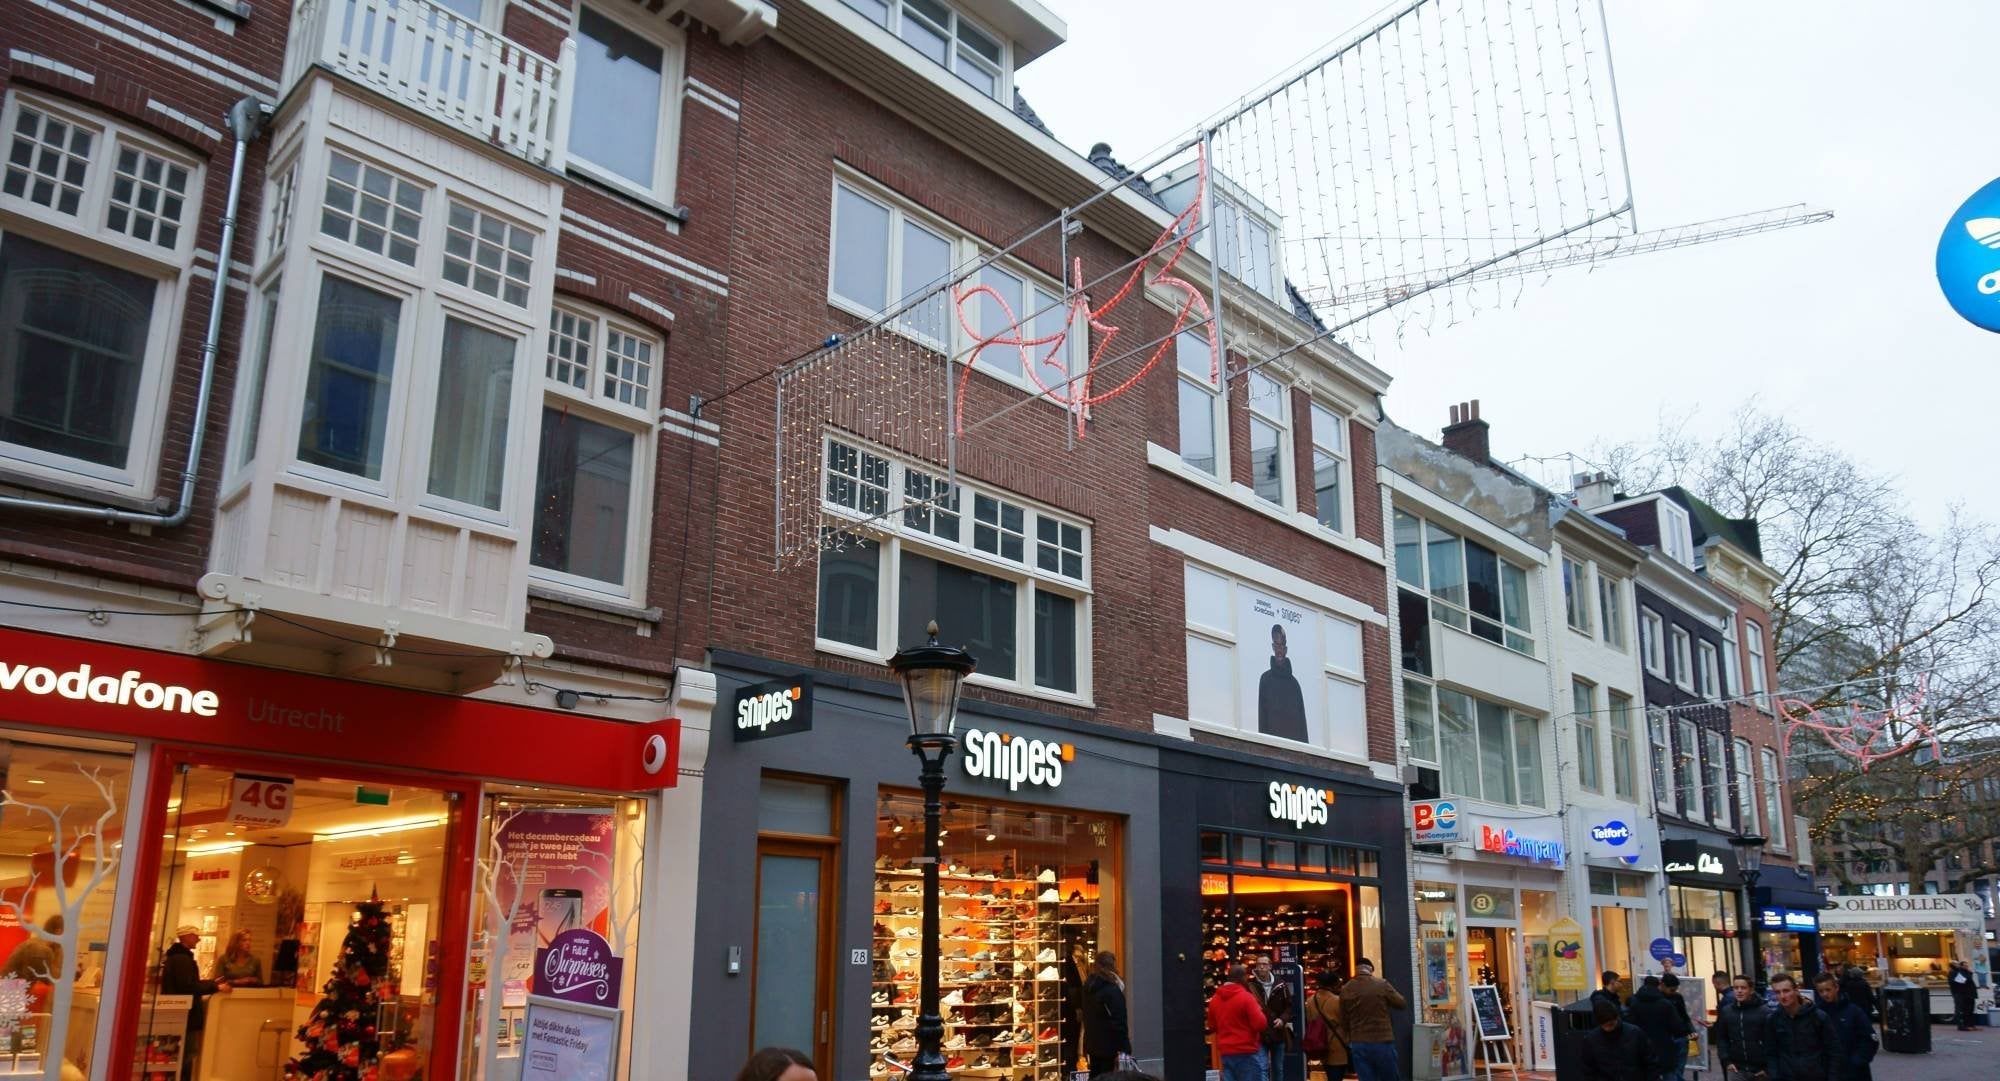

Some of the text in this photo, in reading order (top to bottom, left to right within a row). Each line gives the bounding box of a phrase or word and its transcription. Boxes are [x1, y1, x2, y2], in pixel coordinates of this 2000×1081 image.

[0, 662, 219, 716] vodafone
[248, 697, 345, 733] Utrecht
[240, 782, 287, 810] 4G
[508, 832, 601, 842] Het decembercadeau
[1416, 832, 1459, 840] BelCompany
[1593, 827, 1628, 839] Telfort
[530, 842, 539, 851] je
[540, 842, 562, 850] twee
[563, 842, 581, 851] jaar
[1482, 824, 1563, 865] BelCompany
[557, 852, 578, 860] hebt
[1846, 898, 1957, 911] OLIEBOLLEN
[854, 951, 866, 963] 28
[545, 943, 607, 987] Surprises
[533, 1018, 581, 1036] Altijd dikke deals
[532, 1032, 589, 1054] met Fantastic Friday
